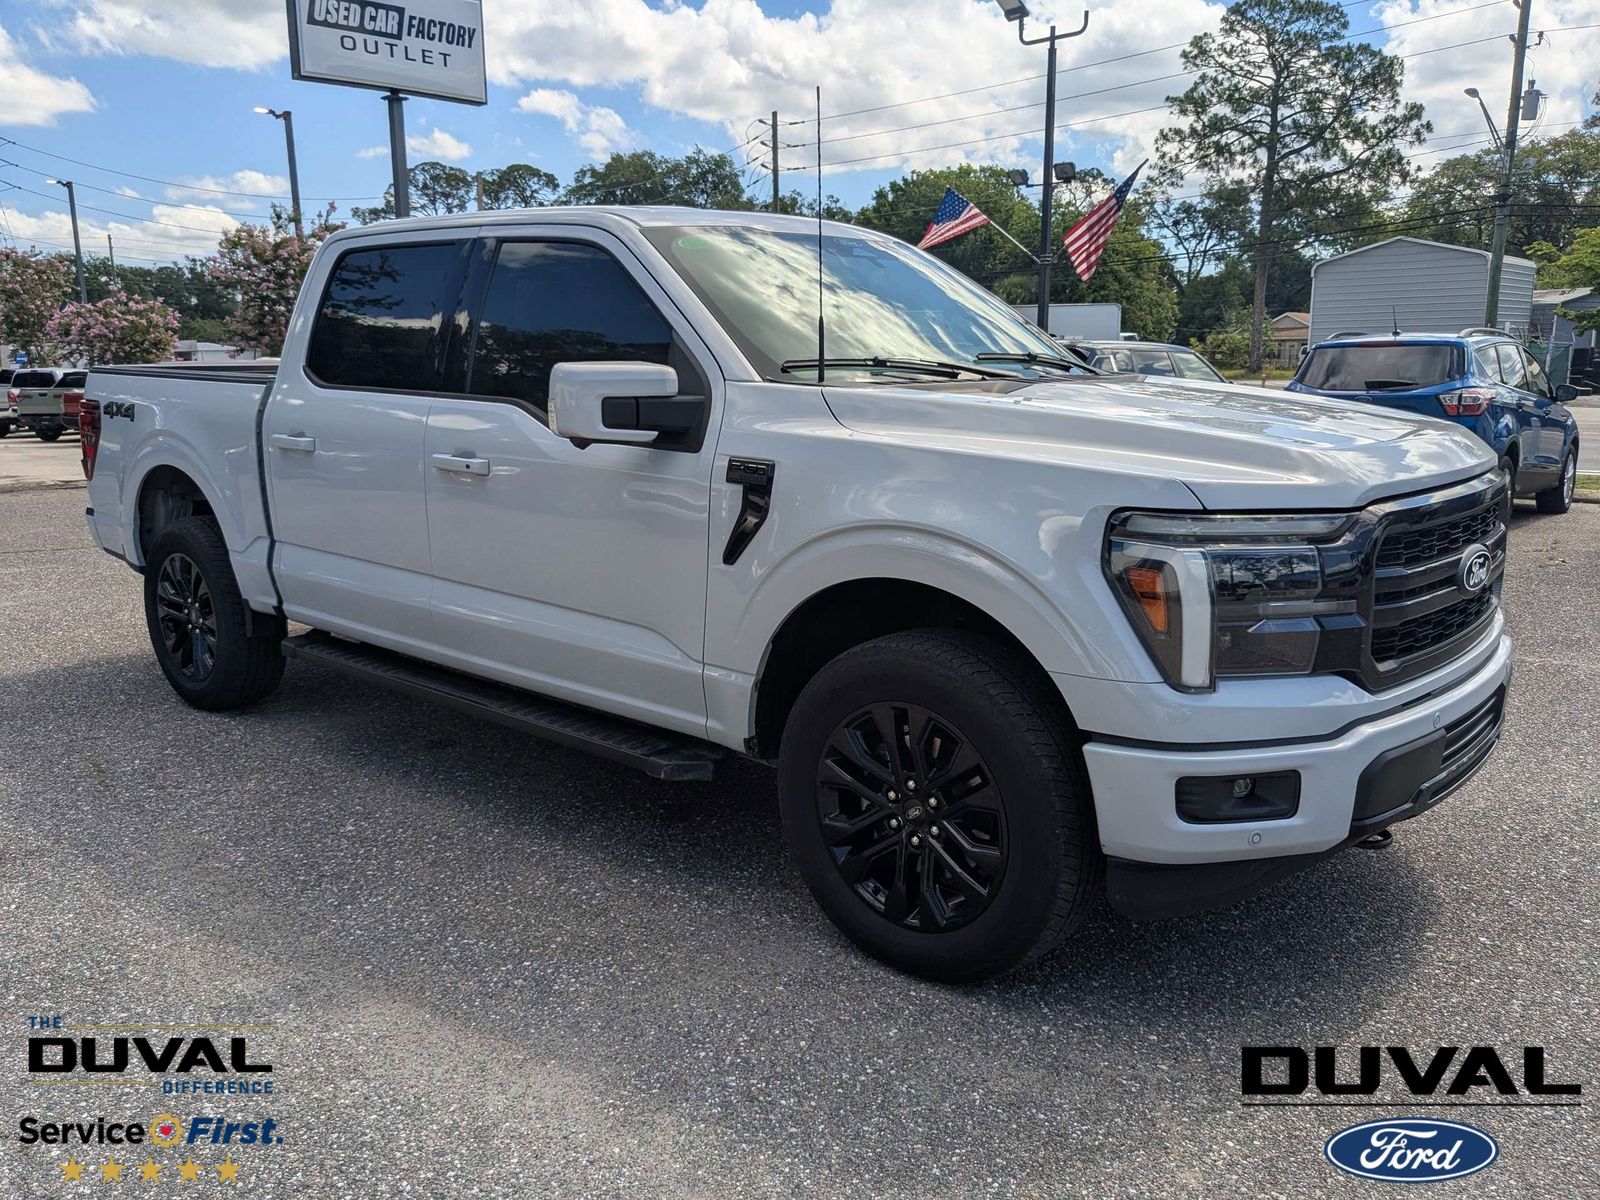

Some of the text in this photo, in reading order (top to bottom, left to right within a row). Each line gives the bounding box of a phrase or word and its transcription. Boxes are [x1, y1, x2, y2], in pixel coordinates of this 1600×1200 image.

[313, 0, 477, 49] USED CAR FACTORY
[339, 34, 453, 68] OUTLET
[1469, 556, 1488, 586] Ford
